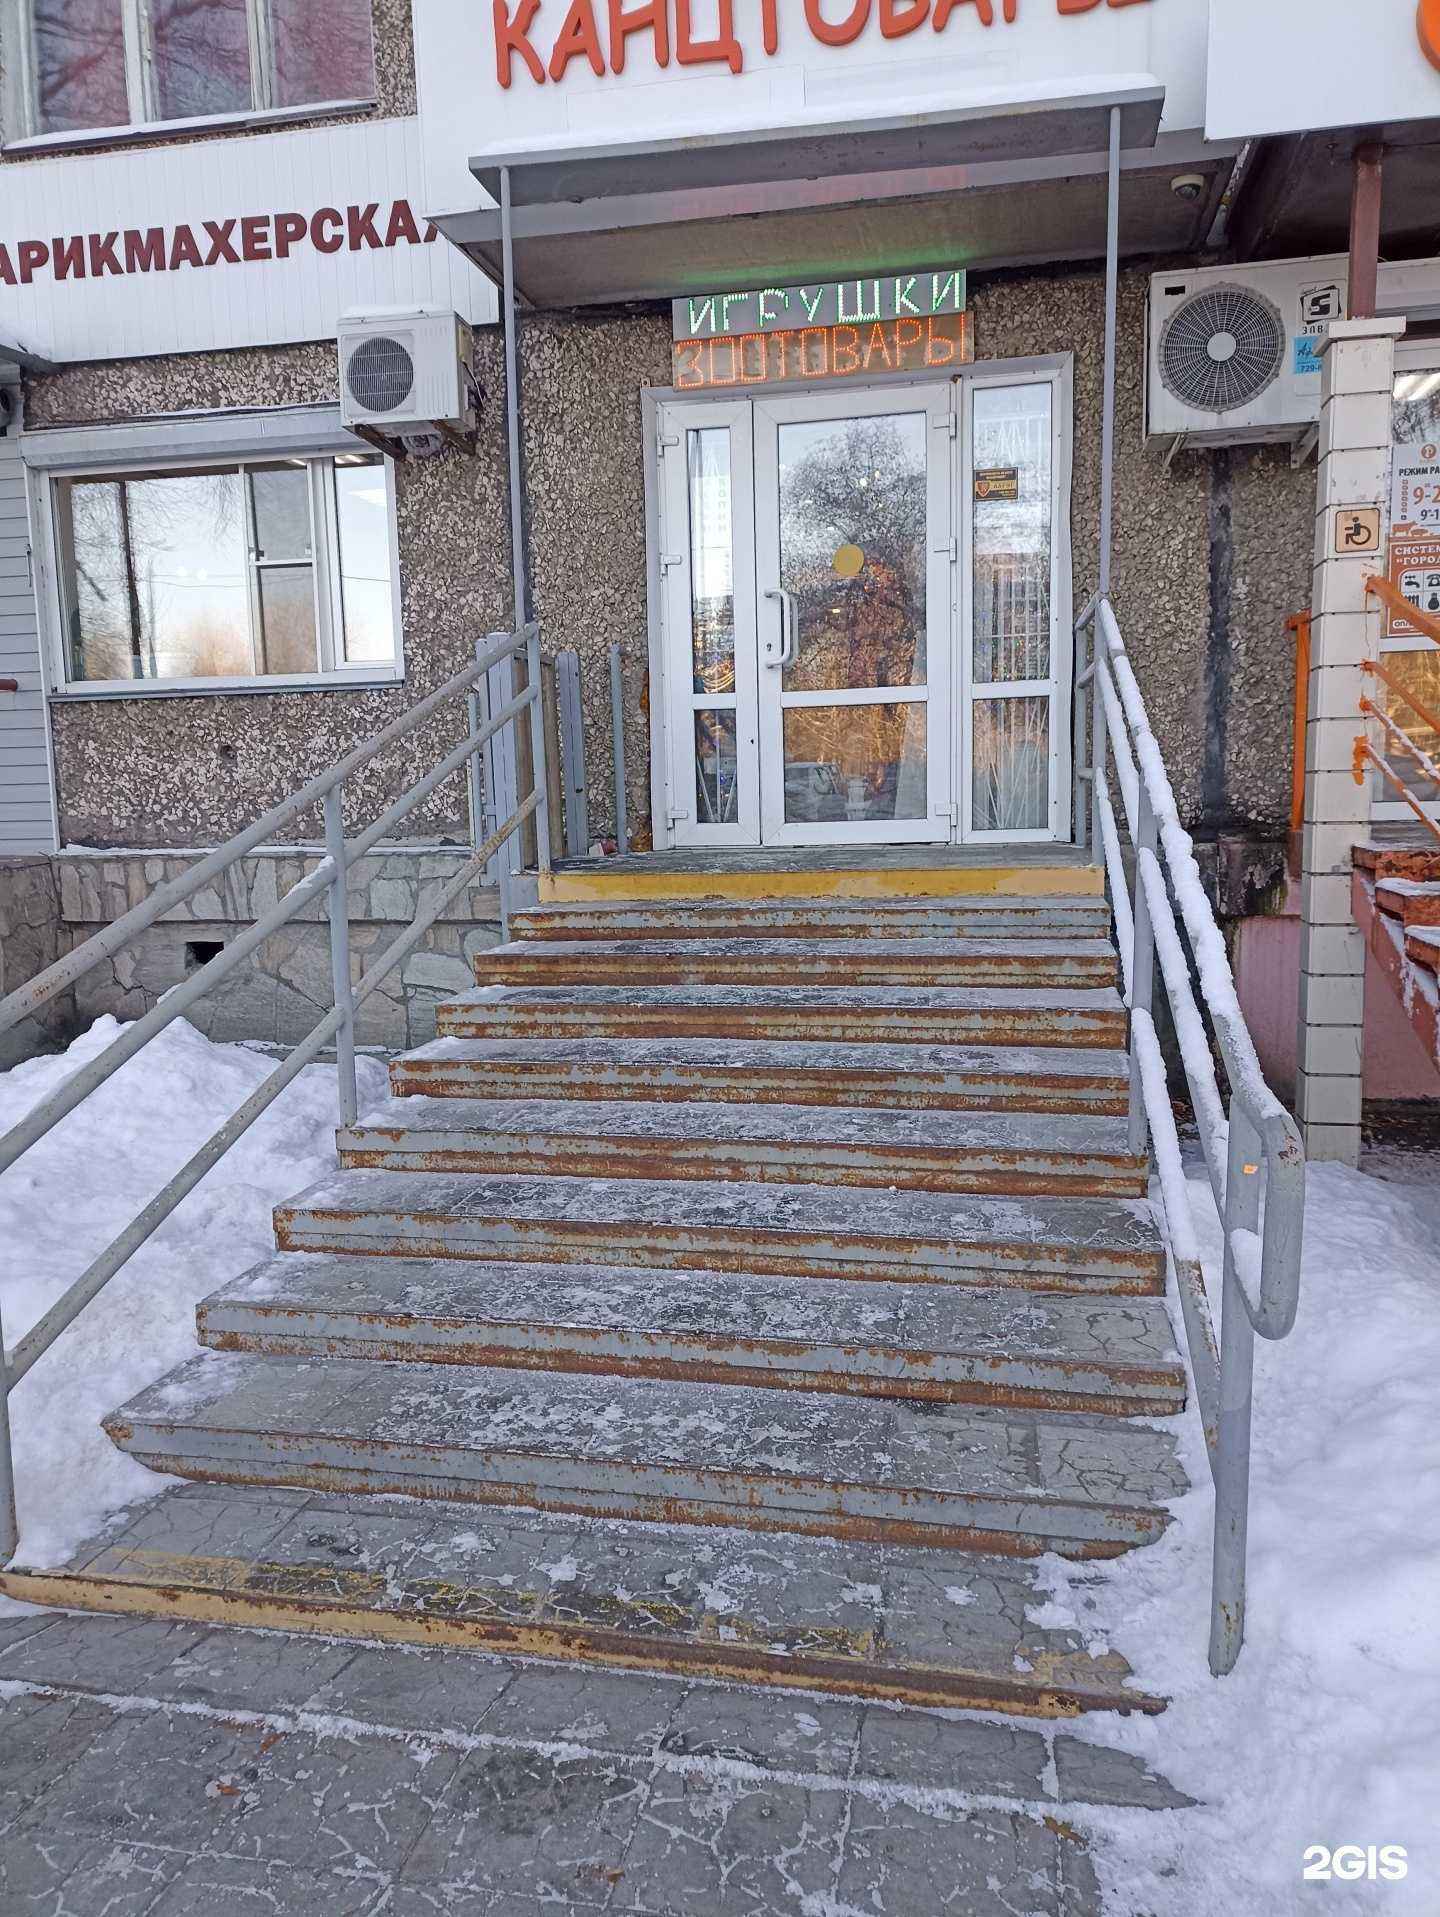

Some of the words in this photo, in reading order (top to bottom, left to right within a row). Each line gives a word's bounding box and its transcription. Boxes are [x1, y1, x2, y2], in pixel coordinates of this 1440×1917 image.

[493, 0, 1152, 88] КАНЦТ
[0, 199, 438, 285] АРИКМАХЕРСКА
[675, 312, 967, 388] ЗООТОВАРЫ
[1399, 467, 1428, 477] РЕЖИМ
